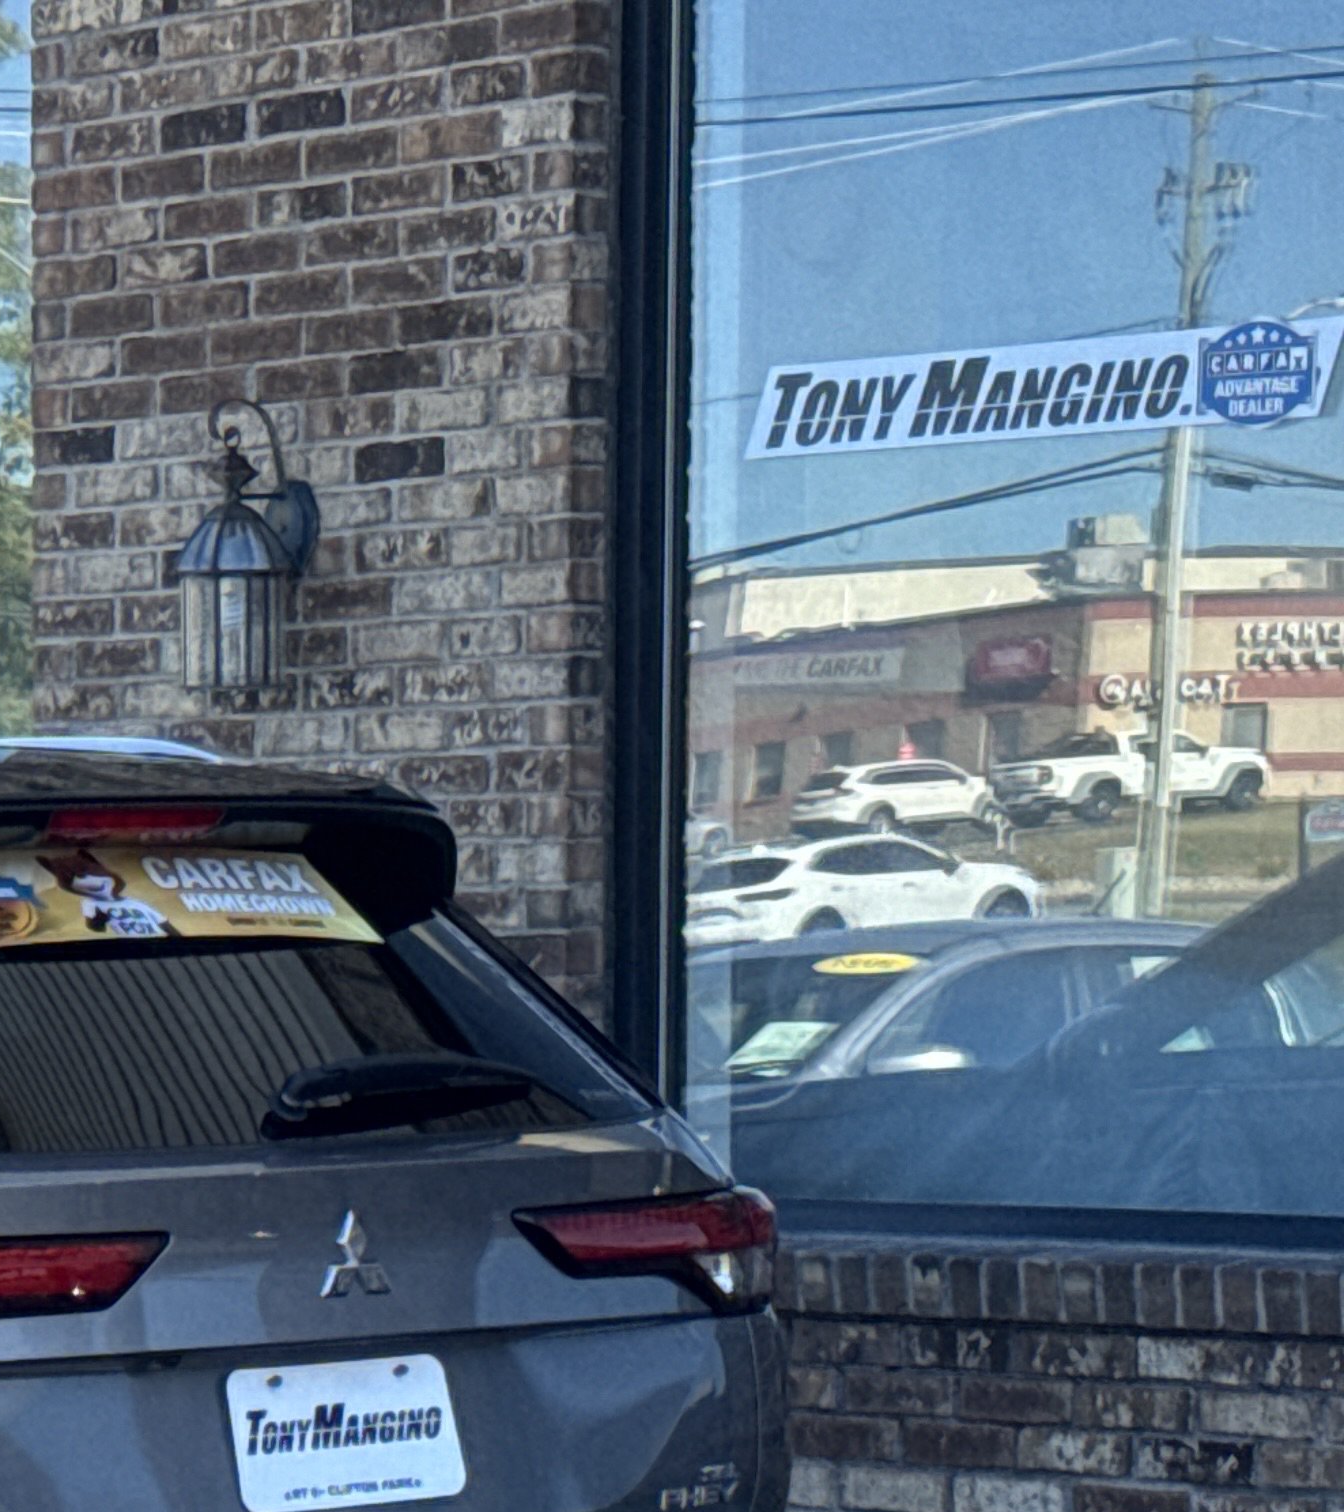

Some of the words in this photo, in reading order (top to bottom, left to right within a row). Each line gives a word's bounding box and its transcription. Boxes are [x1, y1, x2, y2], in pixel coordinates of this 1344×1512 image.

[1210, 347, 1308, 373] CARFAX
[1214, 376, 1304, 397] ADVANTAGE
[765, 371, 916, 449] TONY
[1228, 397, 1285, 417] DEALER
[141, 856, 319, 894] CARFAX
[179, 892, 336, 918] HOMEGROWN
[246, 1408, 312, 1456] TONY
[311, 1402, 442, 1450] MANGINO
